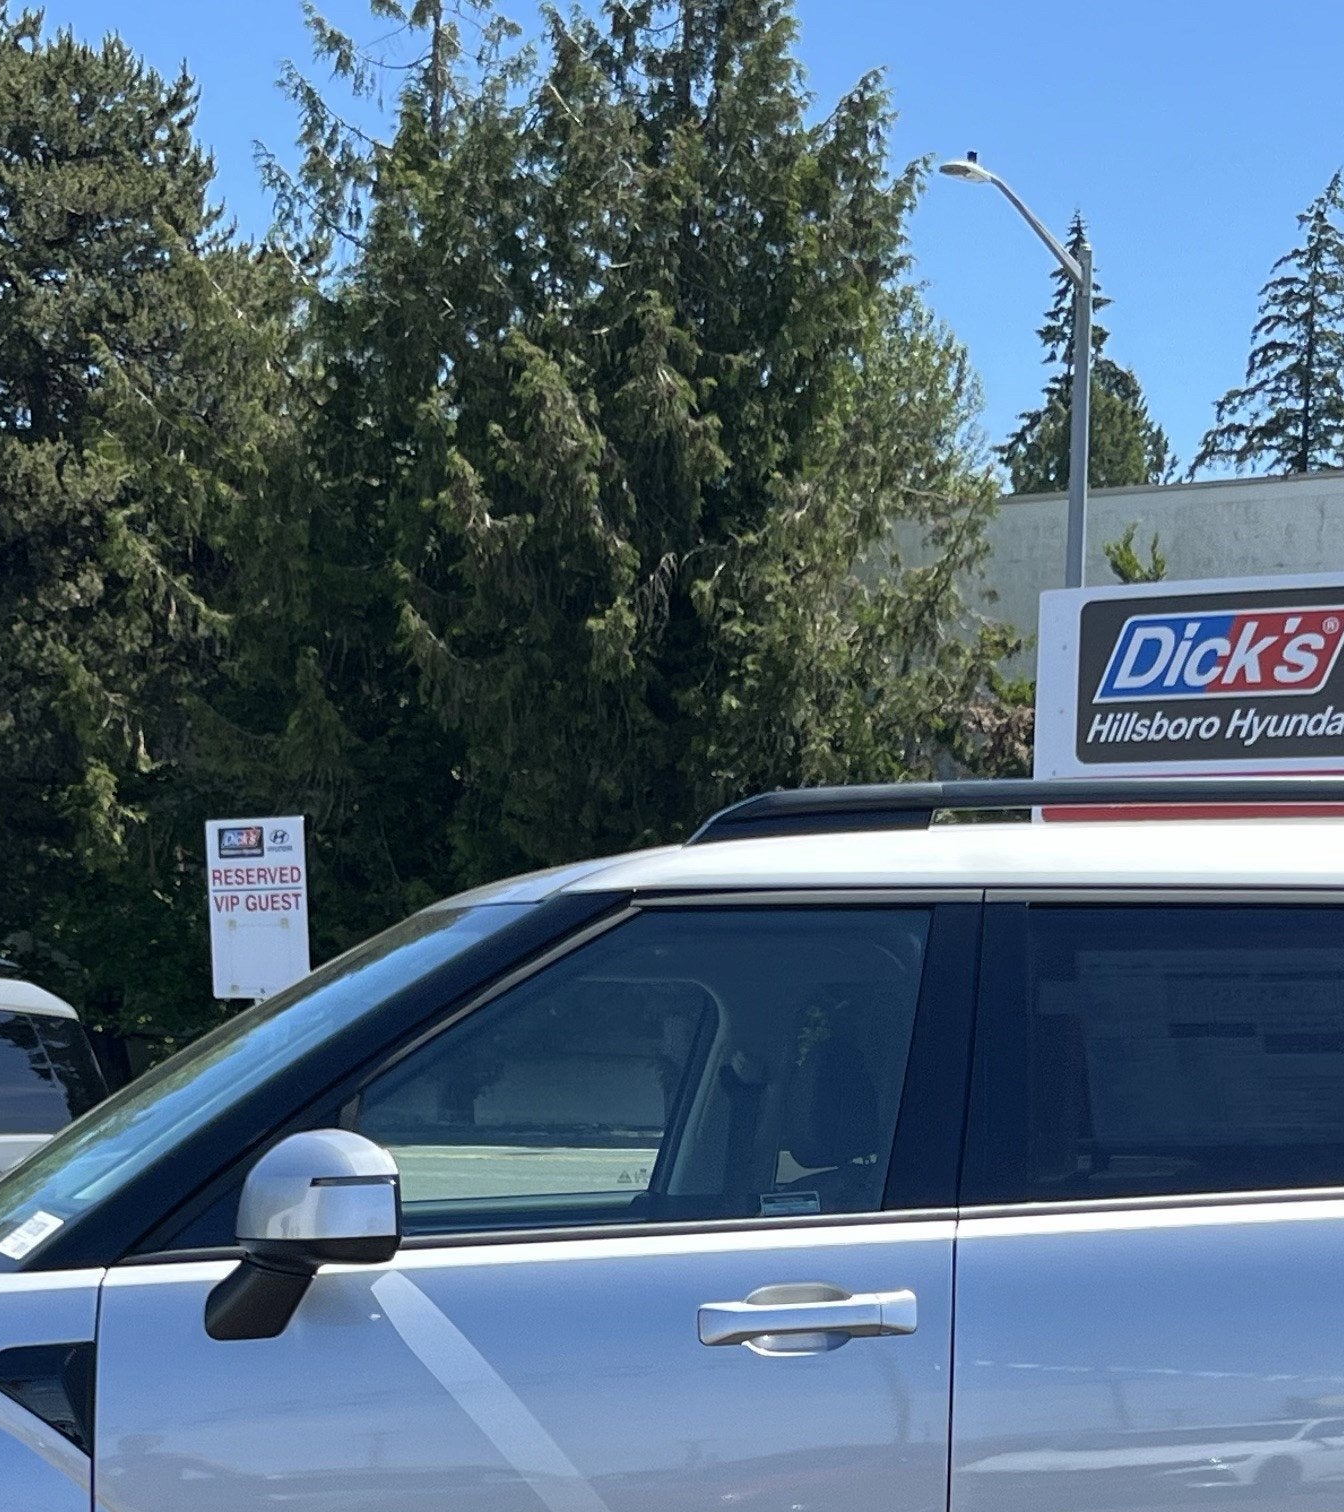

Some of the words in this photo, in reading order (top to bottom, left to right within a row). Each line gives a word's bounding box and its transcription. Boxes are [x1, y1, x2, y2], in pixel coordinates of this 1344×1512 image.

[1112, 616, 1326, 690] Dick's
[1086, 709, 1221, 743] Hillsboro
[212, 866, 302, 886] RESERVED
[214, 895, 240, 913] VIP
[245, 893, 302, 912] GUEST
